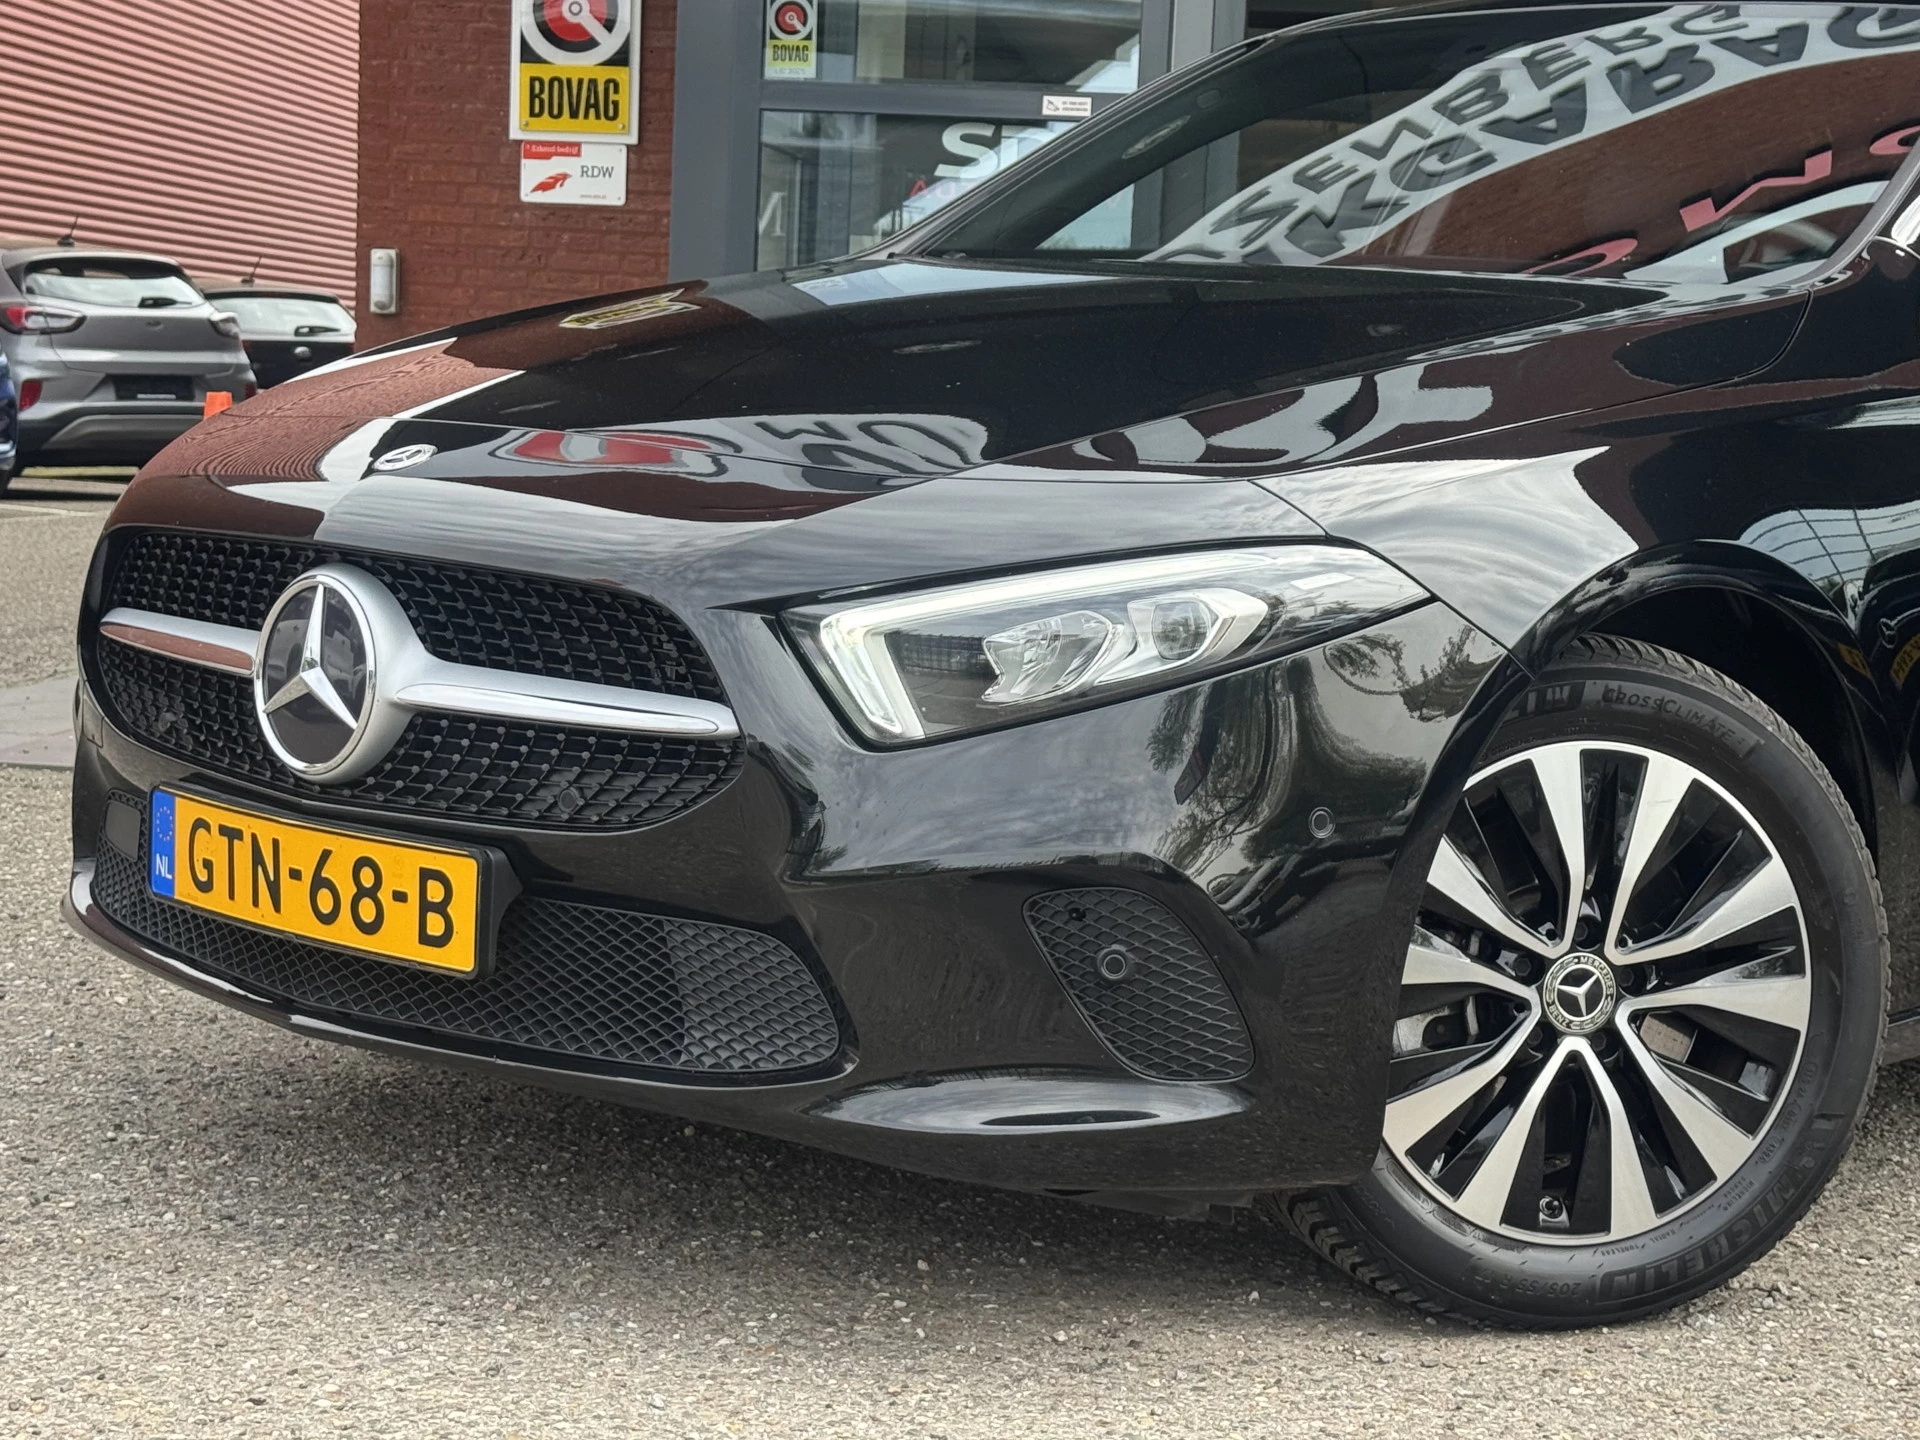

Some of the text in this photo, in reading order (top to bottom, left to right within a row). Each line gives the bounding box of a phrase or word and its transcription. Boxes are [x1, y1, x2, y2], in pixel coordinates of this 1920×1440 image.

[773, 43, 809, 63] BOVAG
[528, 75, 621, 121] BOVAG
[580, 164, 615, 179] RDW
[155, 853, 173, 881] NL
[188, 816, 455, 949] GTN-68-B
[1580, 956, 1614, 995] MERCEDES
[1548, 1005, 1570, 1027] BENZ
[1612, 1174, 1799, 1296] MICHELIN
